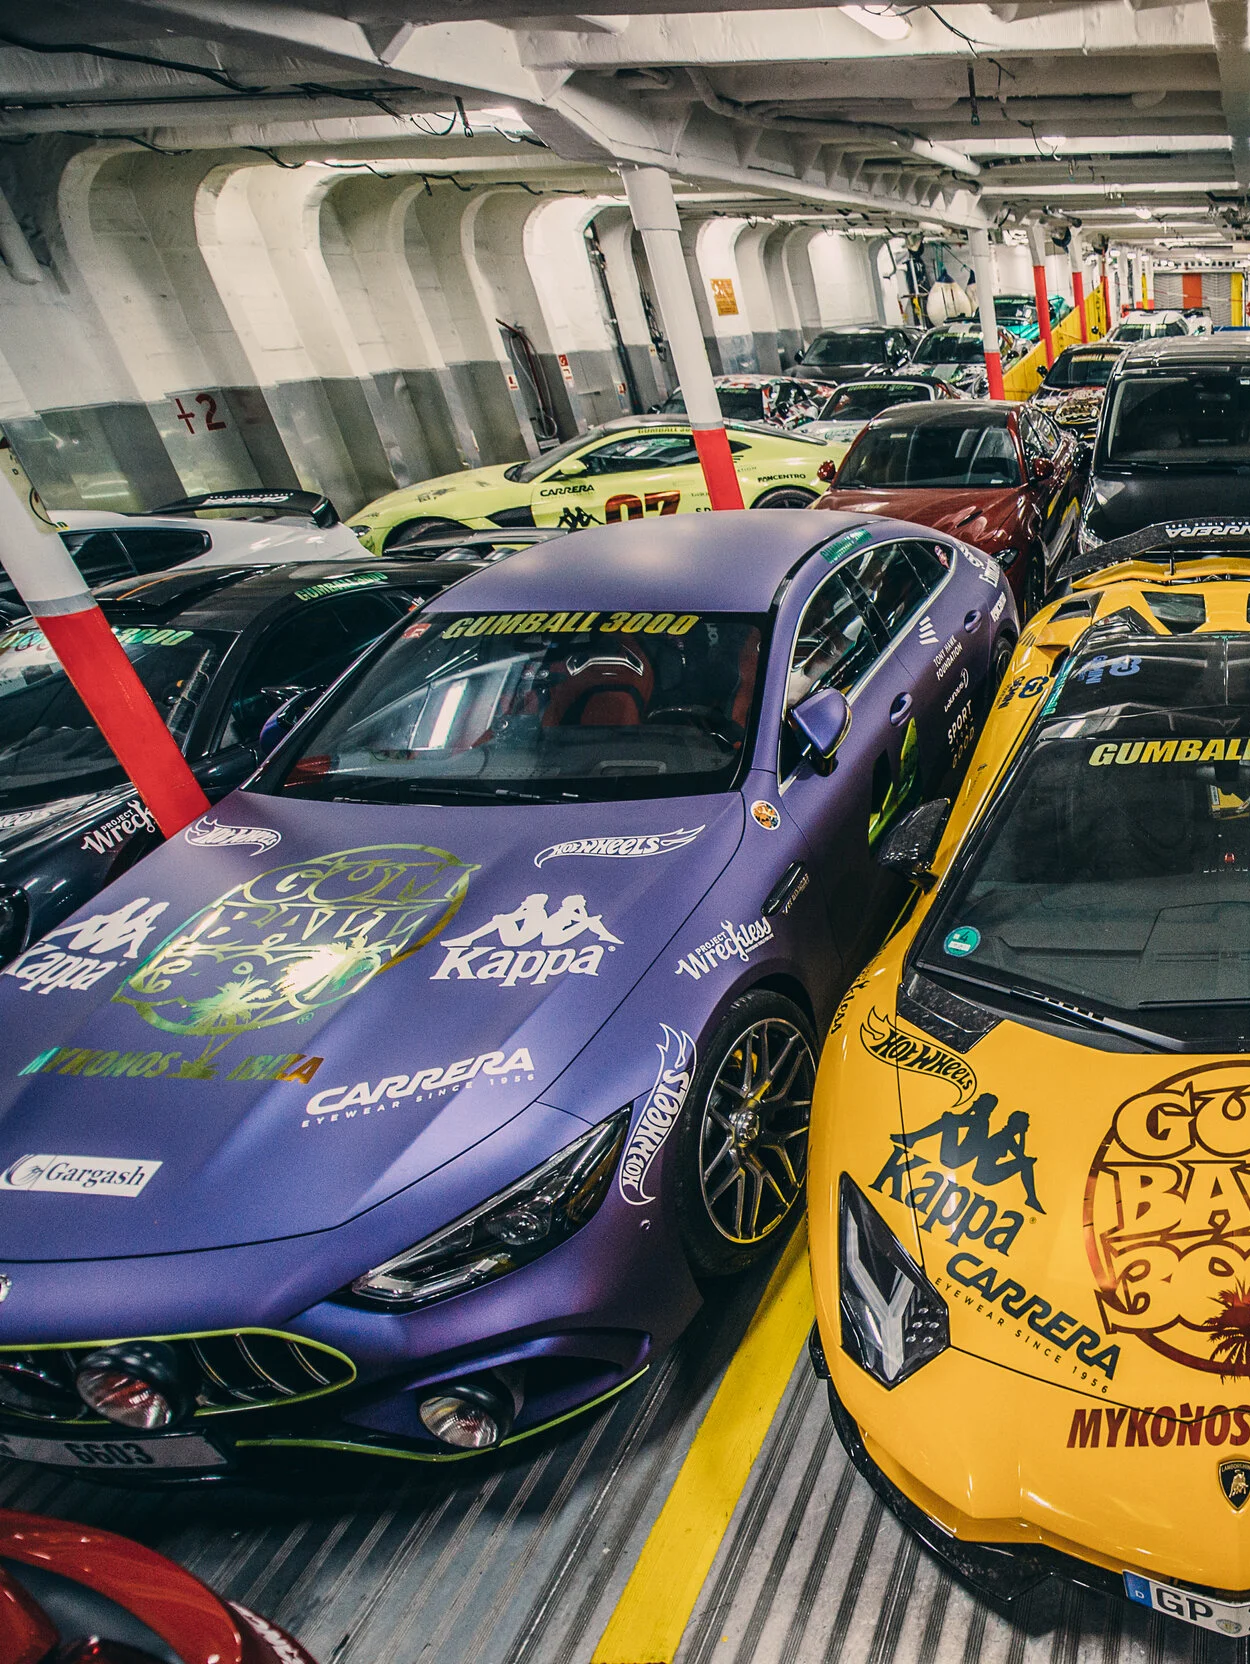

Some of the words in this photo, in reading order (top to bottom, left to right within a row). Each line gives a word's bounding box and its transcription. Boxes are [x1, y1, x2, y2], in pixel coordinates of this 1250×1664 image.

[540, 484, 595, 497] CARRERA
[442, 612, 600, 639] GUMBALL
[600, 612, 699, 635] 3000
[936, 641, 964, 682] FOUNDATION
[947, 700, 974, 746] SPORT
[81, 800, 156, 855] Wreck
[101, 809, 135, 833] PROJECT
[674, 916, 773, 982] Wreckless
[695, 930, 729, 955] PROJECT
[959, 931, 971, 942] 4
[429, 944, 605, 987] Kappa
[306, 1047, 536, 1116] CARRERA
[909, 1044, 975, 1093] WHEELS
[301, 1099, 401, 1128] EYEWEAR
[415, 1080, 474, 1104] SINCE
[489, 1072, 536, 1086] 1956
[46, 1162, 147, 1189] Gargash
[868, 1142, 1025, 1257] Kappa
[934, 1276, 1006, 1328] EYEWEAR
[1014, 1327, 1062, 1365] SINCE
[1071, 1364, 1110, 1395] 1956
[945, 1252, 1122, 1381] CARRERA
[66, 1442, 154, 1466] 6603
[1135, 1589, 1145, 1600] D
[1154, 1587, 1214, 1623] GP
